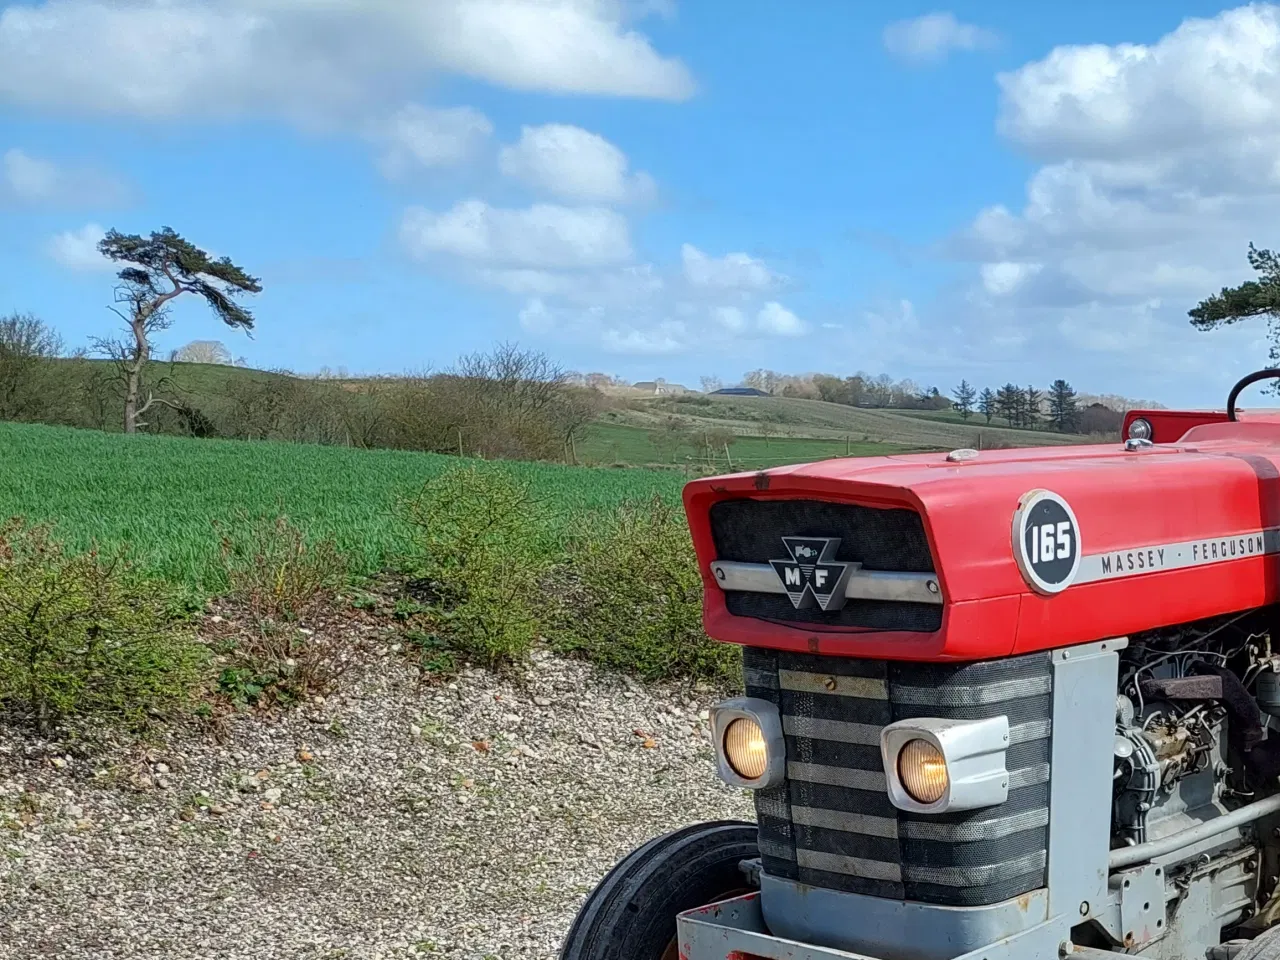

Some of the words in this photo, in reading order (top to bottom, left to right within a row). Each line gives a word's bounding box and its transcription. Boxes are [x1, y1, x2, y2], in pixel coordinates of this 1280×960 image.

[1031, 521, 1071, 564] 165
[1101, 549, 1165, 575] MASSEY
[1192, 535, 1263, 562] FERGUSON
